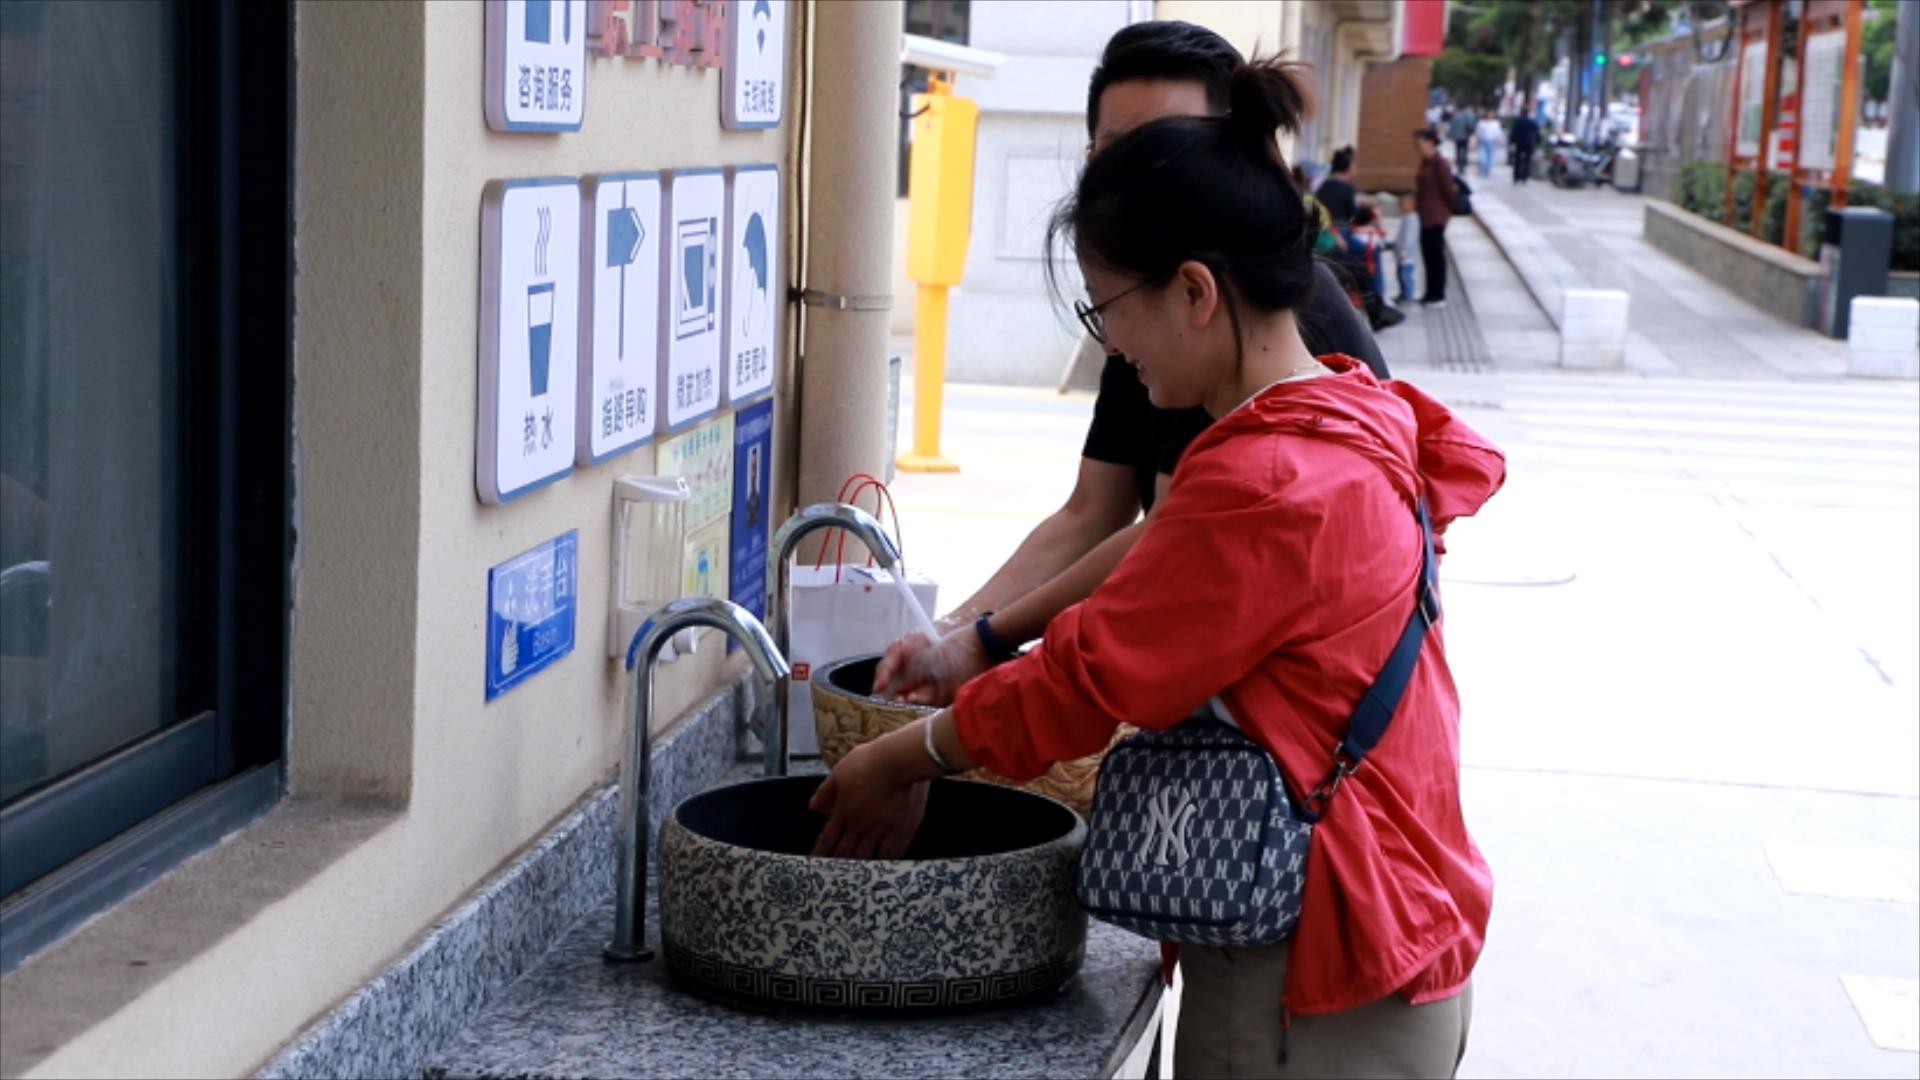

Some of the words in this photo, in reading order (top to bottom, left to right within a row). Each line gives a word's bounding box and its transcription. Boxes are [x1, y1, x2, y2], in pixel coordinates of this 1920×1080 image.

[518, 64, 573, 112] 咨询服务
[742, 79, 776, 113] 无线网络
[523, 405, 553, 457] 热水
[525, 556, 568, 618] 洗手台
[1138, 784, 1198, 868] NY
